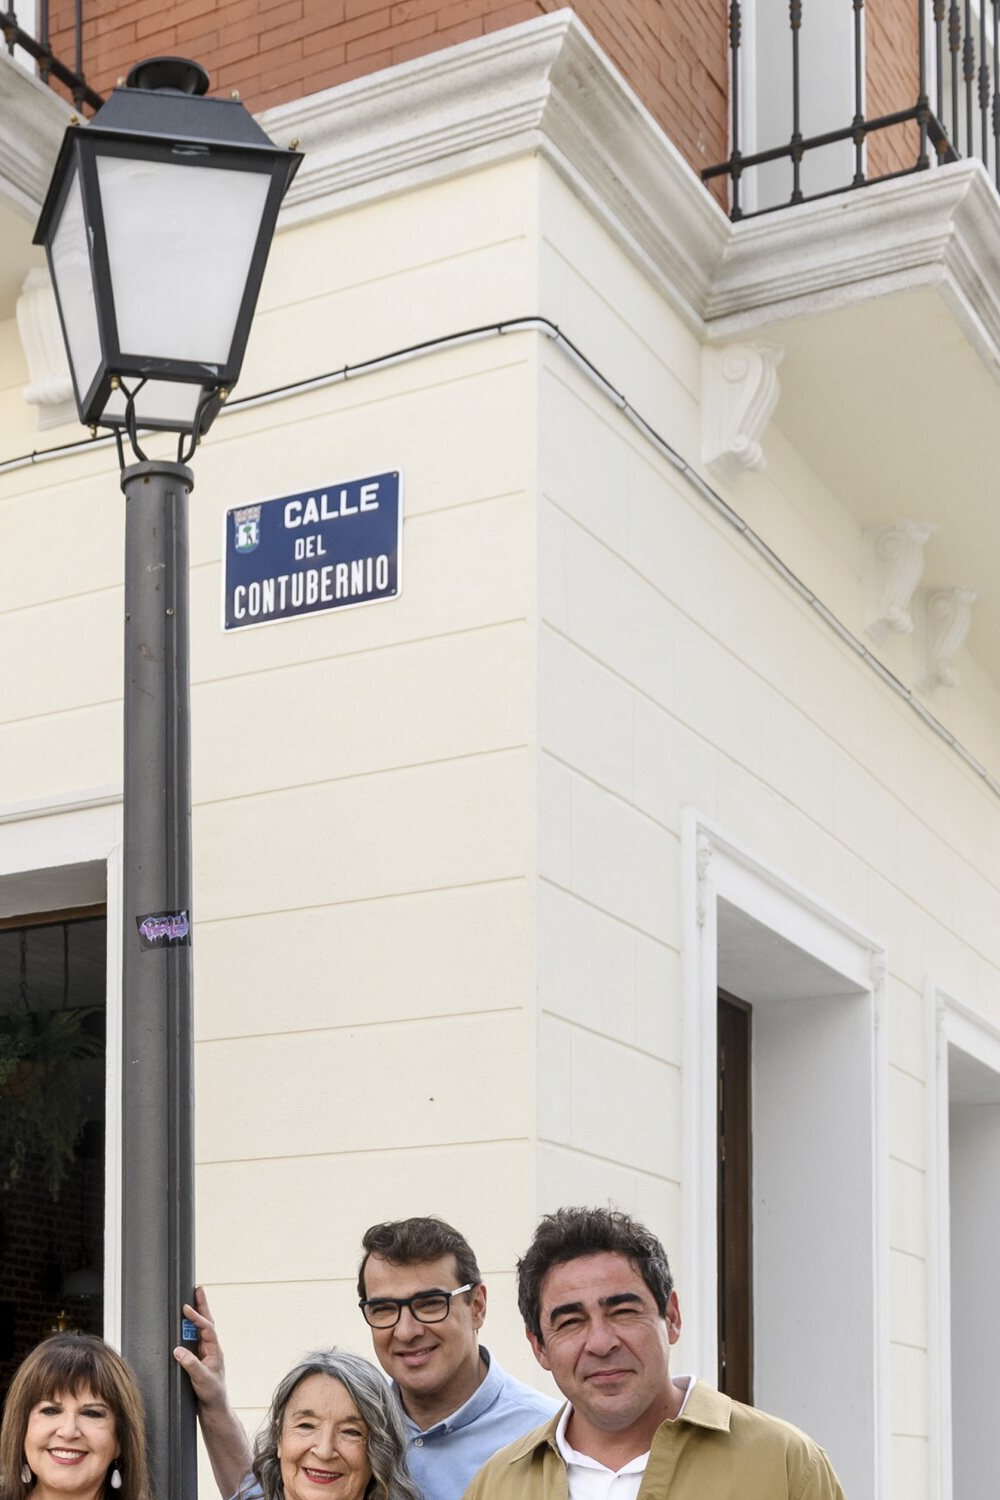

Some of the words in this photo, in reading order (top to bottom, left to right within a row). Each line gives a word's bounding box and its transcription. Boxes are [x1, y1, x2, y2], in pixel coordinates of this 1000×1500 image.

[284, 483, 380, 529] CALLE
[295, 534, 327, 561] DEL
[233, 554, 389, 620] CONTUBERNIO
